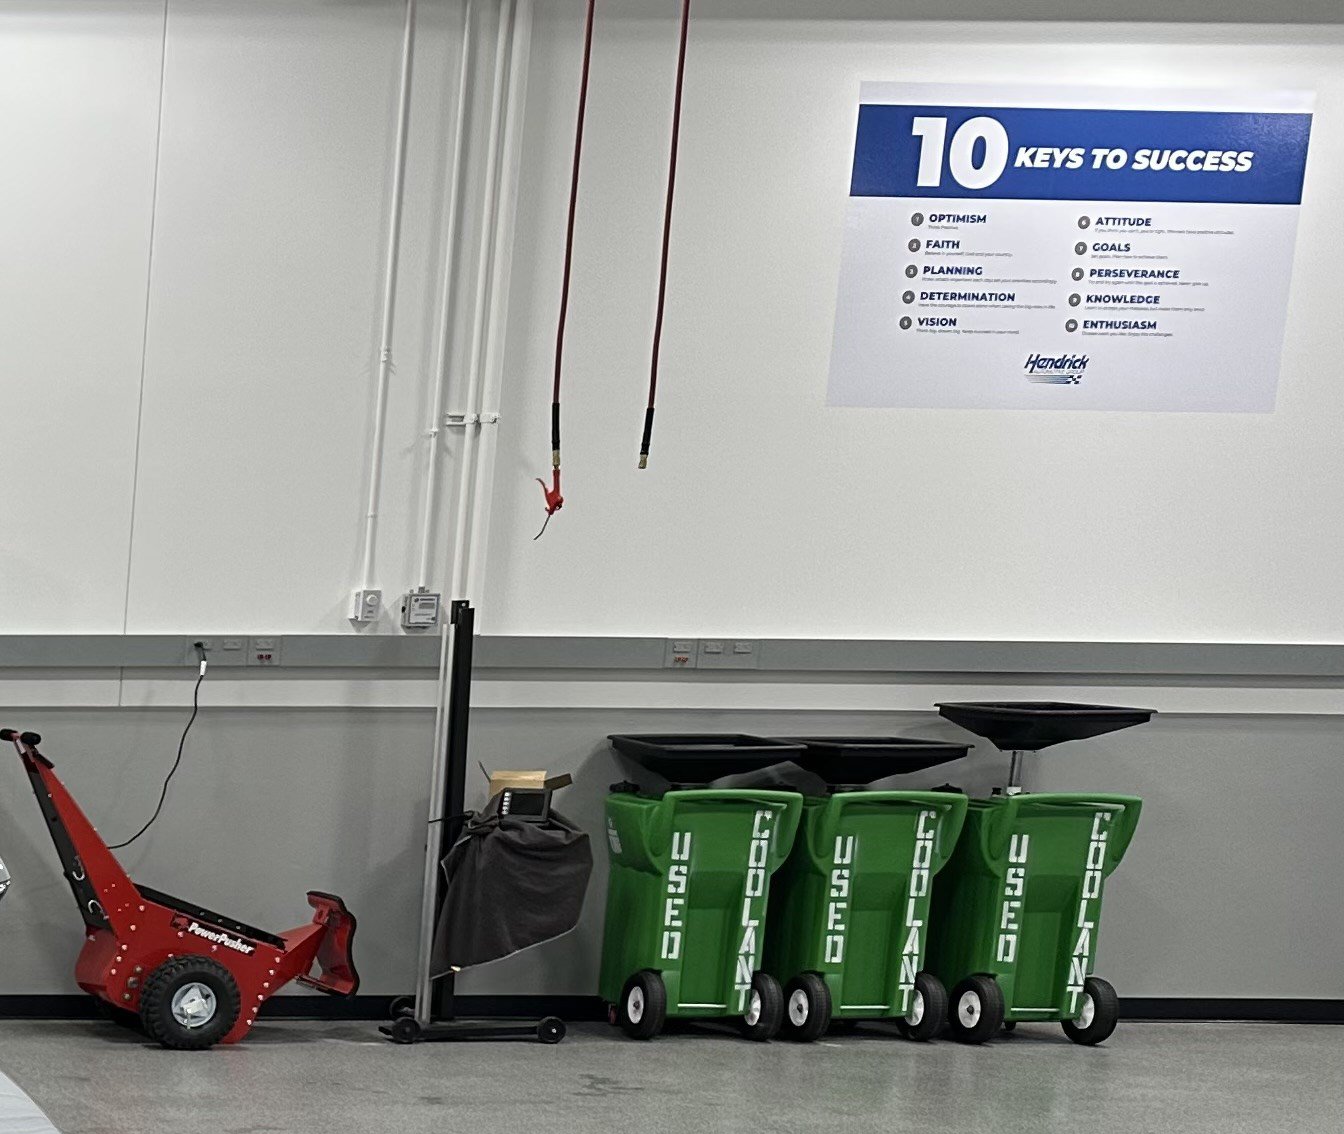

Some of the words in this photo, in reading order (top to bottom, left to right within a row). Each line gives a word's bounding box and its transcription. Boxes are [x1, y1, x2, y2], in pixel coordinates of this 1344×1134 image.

[911, 116, 1010, 190] 10
[1014, 147, 1086, 168] KEYS
[1091, 148, 1128, 170] TO
[1131, 149, 1255, 172] SUCCESS
[929, 214, 987, 224] OPTIMISM
[1095, 217, 1152, 227] ATTITUDE
[925, 239, 961, 250] FAITH
[1092, 243, 1131, 252] GOALS
[922, 266, 983, 276] PLANNING
[1089, 268, 1180, 279] PERSEVERANCE
[920, 291, 1016, 302] DETERMINATION
[1086, 294, 1161, 305] KNOWLEDGE
[917, 317, 958, 327] VISION
[1082, 320, 1157, 330] ENTHUSIASM
[1024, 354, 1090, 373] Hendrick
[661, 832, 692, 959] USED
[824, 836, 854, 964] USED
[996, 834, 1030, 962] USED
[734, 810, 772, 1012] COOLANT
[898, 810, 937, 1012] COOLANT
[1066, 812, 1112, 1014] COOLANT
[187, 921, 255, 954] PowerPusher
